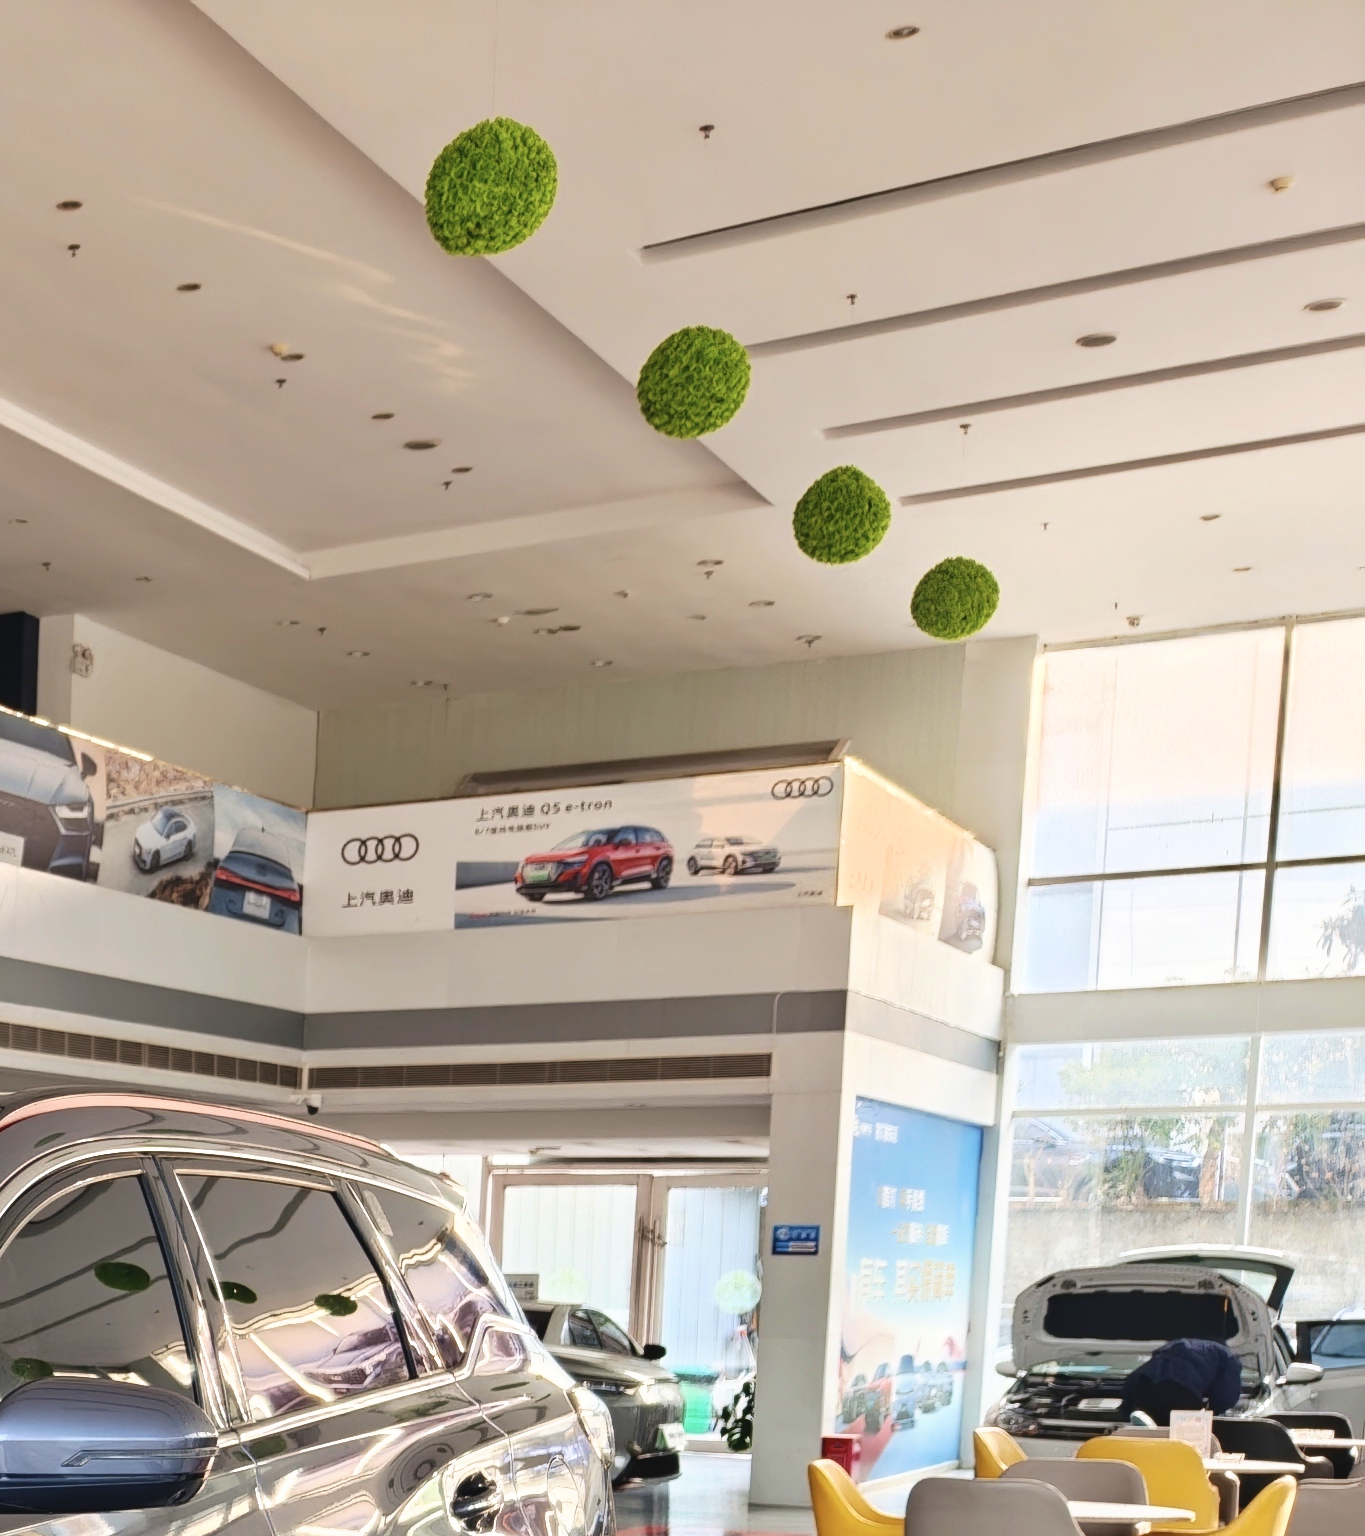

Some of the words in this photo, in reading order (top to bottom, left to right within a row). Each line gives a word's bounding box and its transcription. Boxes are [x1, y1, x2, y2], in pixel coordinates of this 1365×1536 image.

[475, 803, 535, 822] 上汽奥迪
[540, 801, 561, 817] Q5
[341, 888, 414, 909] 上汽奥迪
